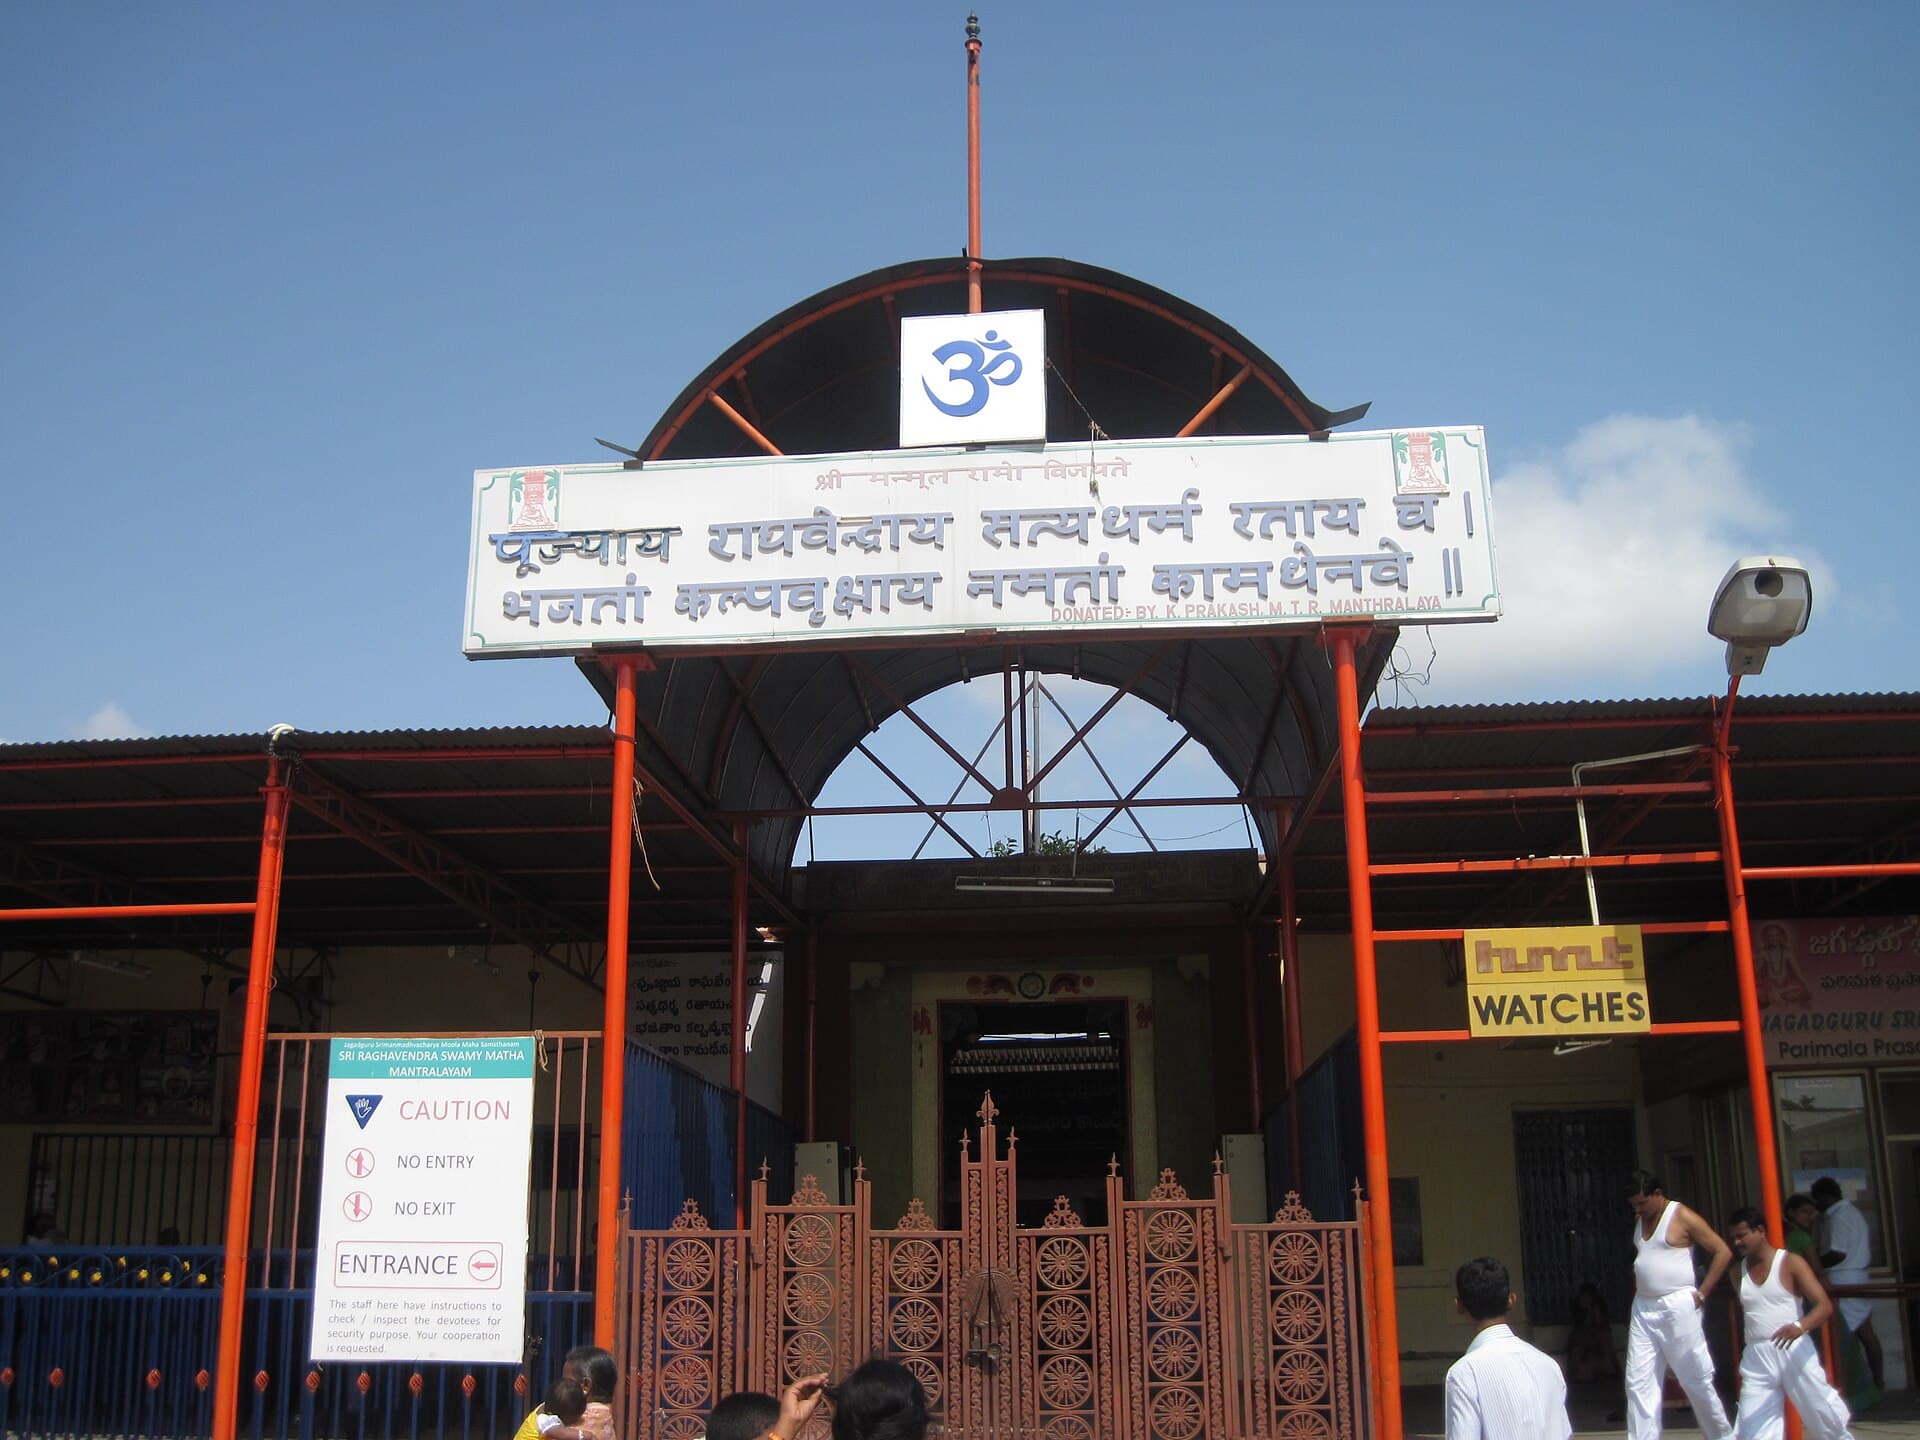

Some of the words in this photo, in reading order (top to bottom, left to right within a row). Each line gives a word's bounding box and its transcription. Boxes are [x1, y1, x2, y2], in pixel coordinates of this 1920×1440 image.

[815, 468, 843, 491] श्री
[1043, 456, 1133, 482] विजयते
[488, 526, 682, 578] पूज्याय
[708, 505, 955, 562] राघवेन्द्राय
[1229, 495, 1366, 541] रताय
[1393, 493, 1440, 533] च
[502, 572, 652, 627] भजतां
[674, 570, 943, 629] कल्पवृक्षाय
[966, 552, 1126, 608] नमतां
[1151, 536, 1414, 601] कामधेनवे
[1136, 604, 1158, 620] BY.
[1166, 603, 1181, 619] K.
[1269, 601, 1287, 617] M.
[1290, 600, 1304, 616] T.
[1308, 599, 1323, 615] R.
[1330, 595, 1442, 614] MANTHRALAYA
[1472, 991, 1646, 1026] WATCHES
[338, 1050, 356, 1061] SRI
[357, 1050, 439, 1062] RAGHAVENDRA
[441, 1050, 482, 1061] SWAMY
[484, 1050, 525, 1061] MATHA
[1779, 1040, 1868, 1058] Parimala
[389, 1066, 472, 1077] MANTRALAYAM
[399, 1099, 511, 1121] CAUTION
[397, 1154, 421, 1169] NO
[425, 1154, 475, 1169] ENTRY
[394, 1201, 419, 1216] NO
[423, 1201, 457, 1216] EXIT
[338, 1253, 459, 1275] ENTRANCE
[329, 1299, 348, 1310] The
[351, 1299, 373, 1310] staff
[377, 1300, 399, 1310] here
[403, 1300, 426, 1311] have
[431, 1300, 487, 1311] instructions
[491, 1301, 502, 1312] to
[328, 1313, 356, 1324] check
[373, 1314, 408, 1326] inspect
[414, 1315, 431, 1325] the
[436, 1315, 481, 1326] devotees
[487, 1315, 502, 1326] for
[327, 1328, 365, 1340] security
[369, 1329, 412, 1341] purpose.
[416, 1329, 438, 1340] Your
[442, 1330, 501, 1342] cooperation
[326, 1343, 334, 1353] is
